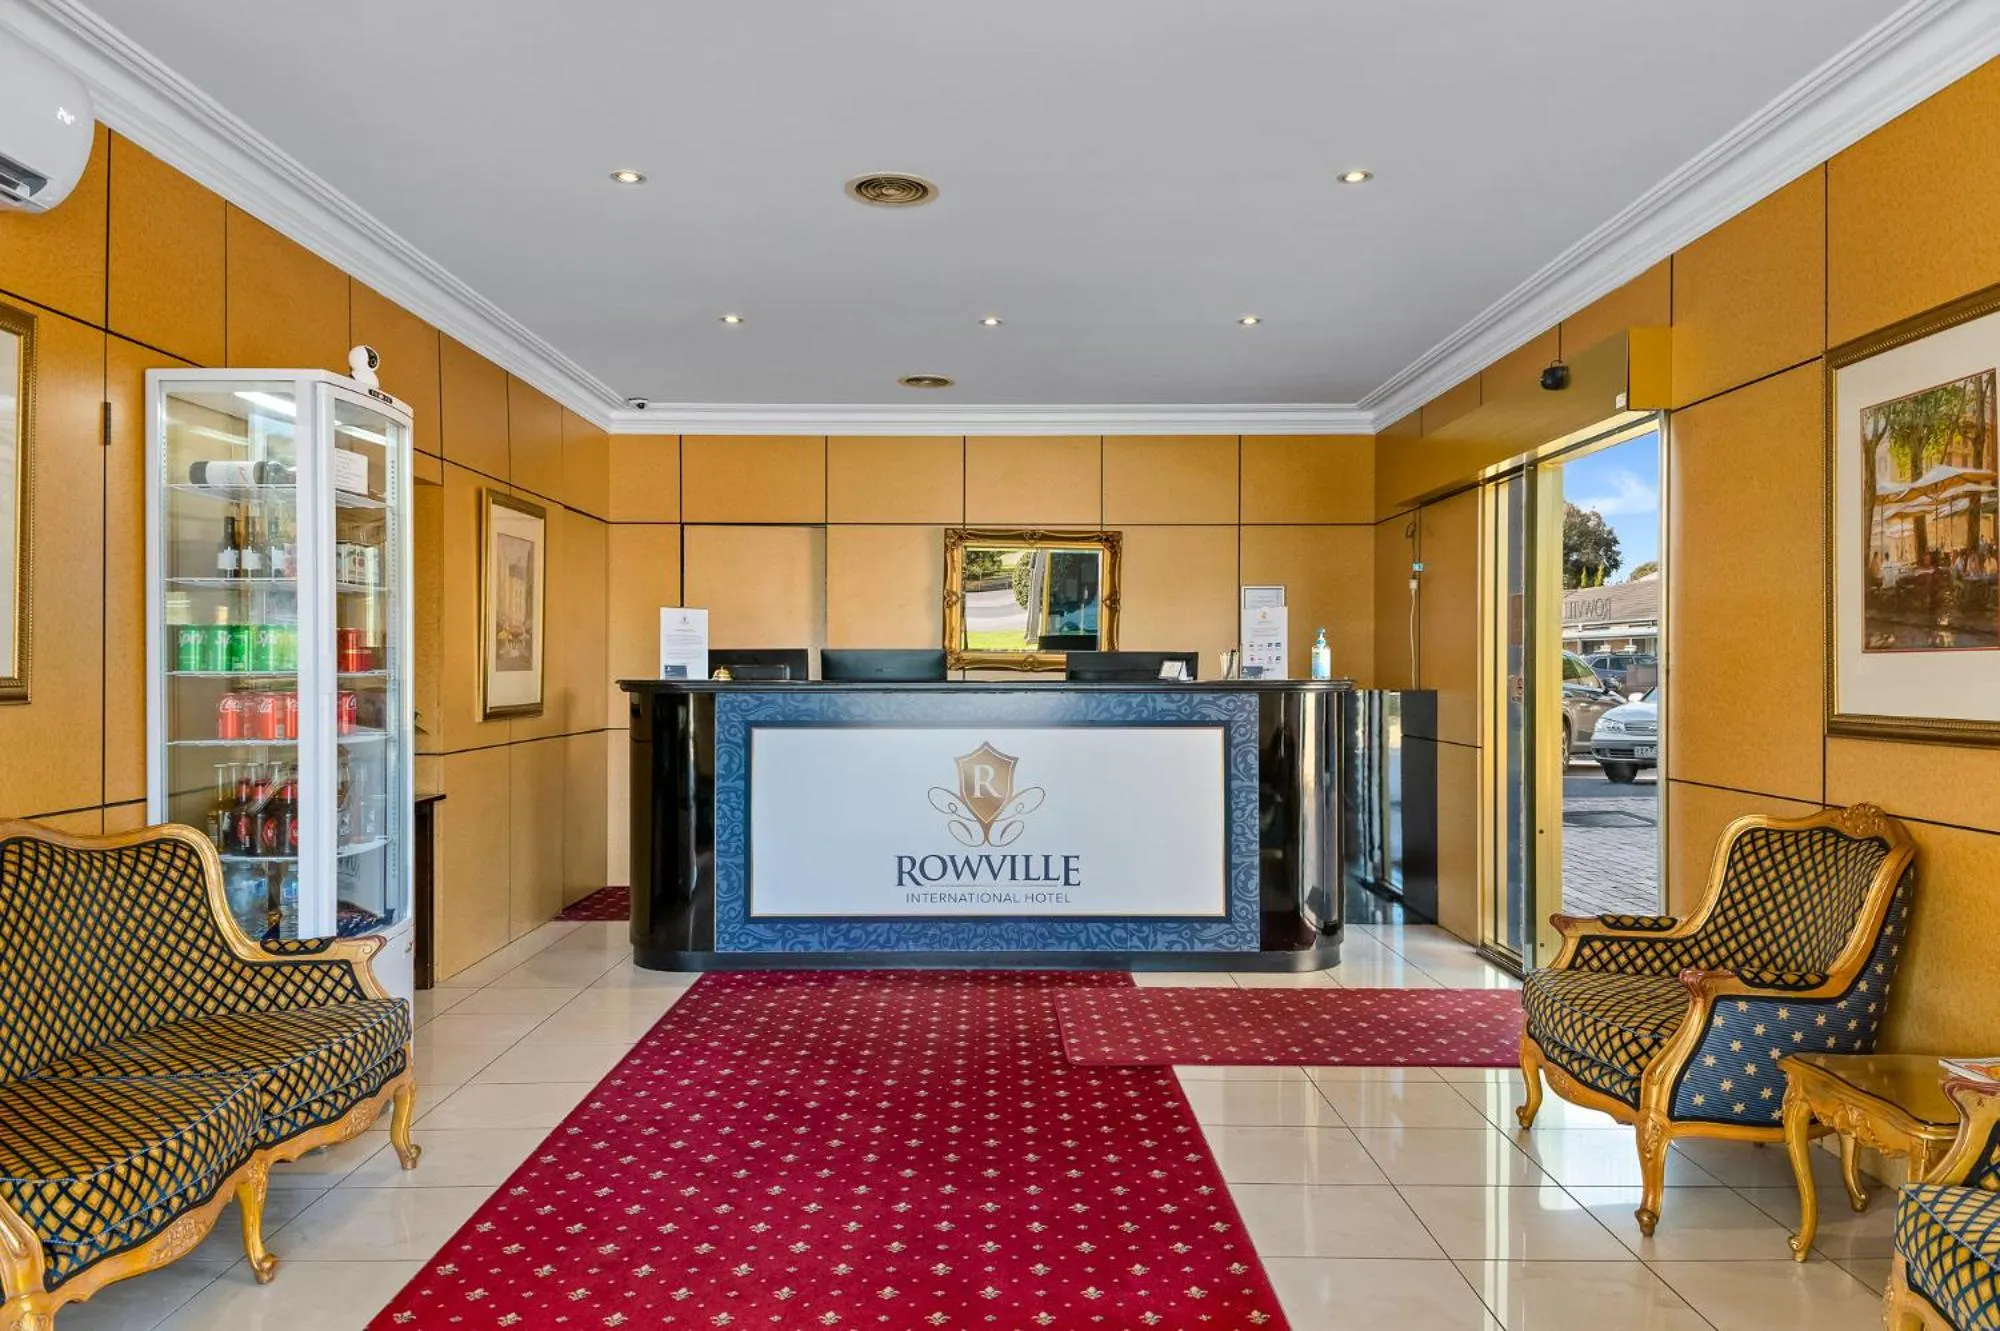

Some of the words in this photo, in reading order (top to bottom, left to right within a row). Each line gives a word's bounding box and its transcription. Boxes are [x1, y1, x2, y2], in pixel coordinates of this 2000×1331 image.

[972, 764, 1004, 798] R
[895, 854, 1081, 887] ROWVILLE
[906, 893, 1019, 904] INTERNATIONAL
[1025, 893, 1071, 904] HOTEL
